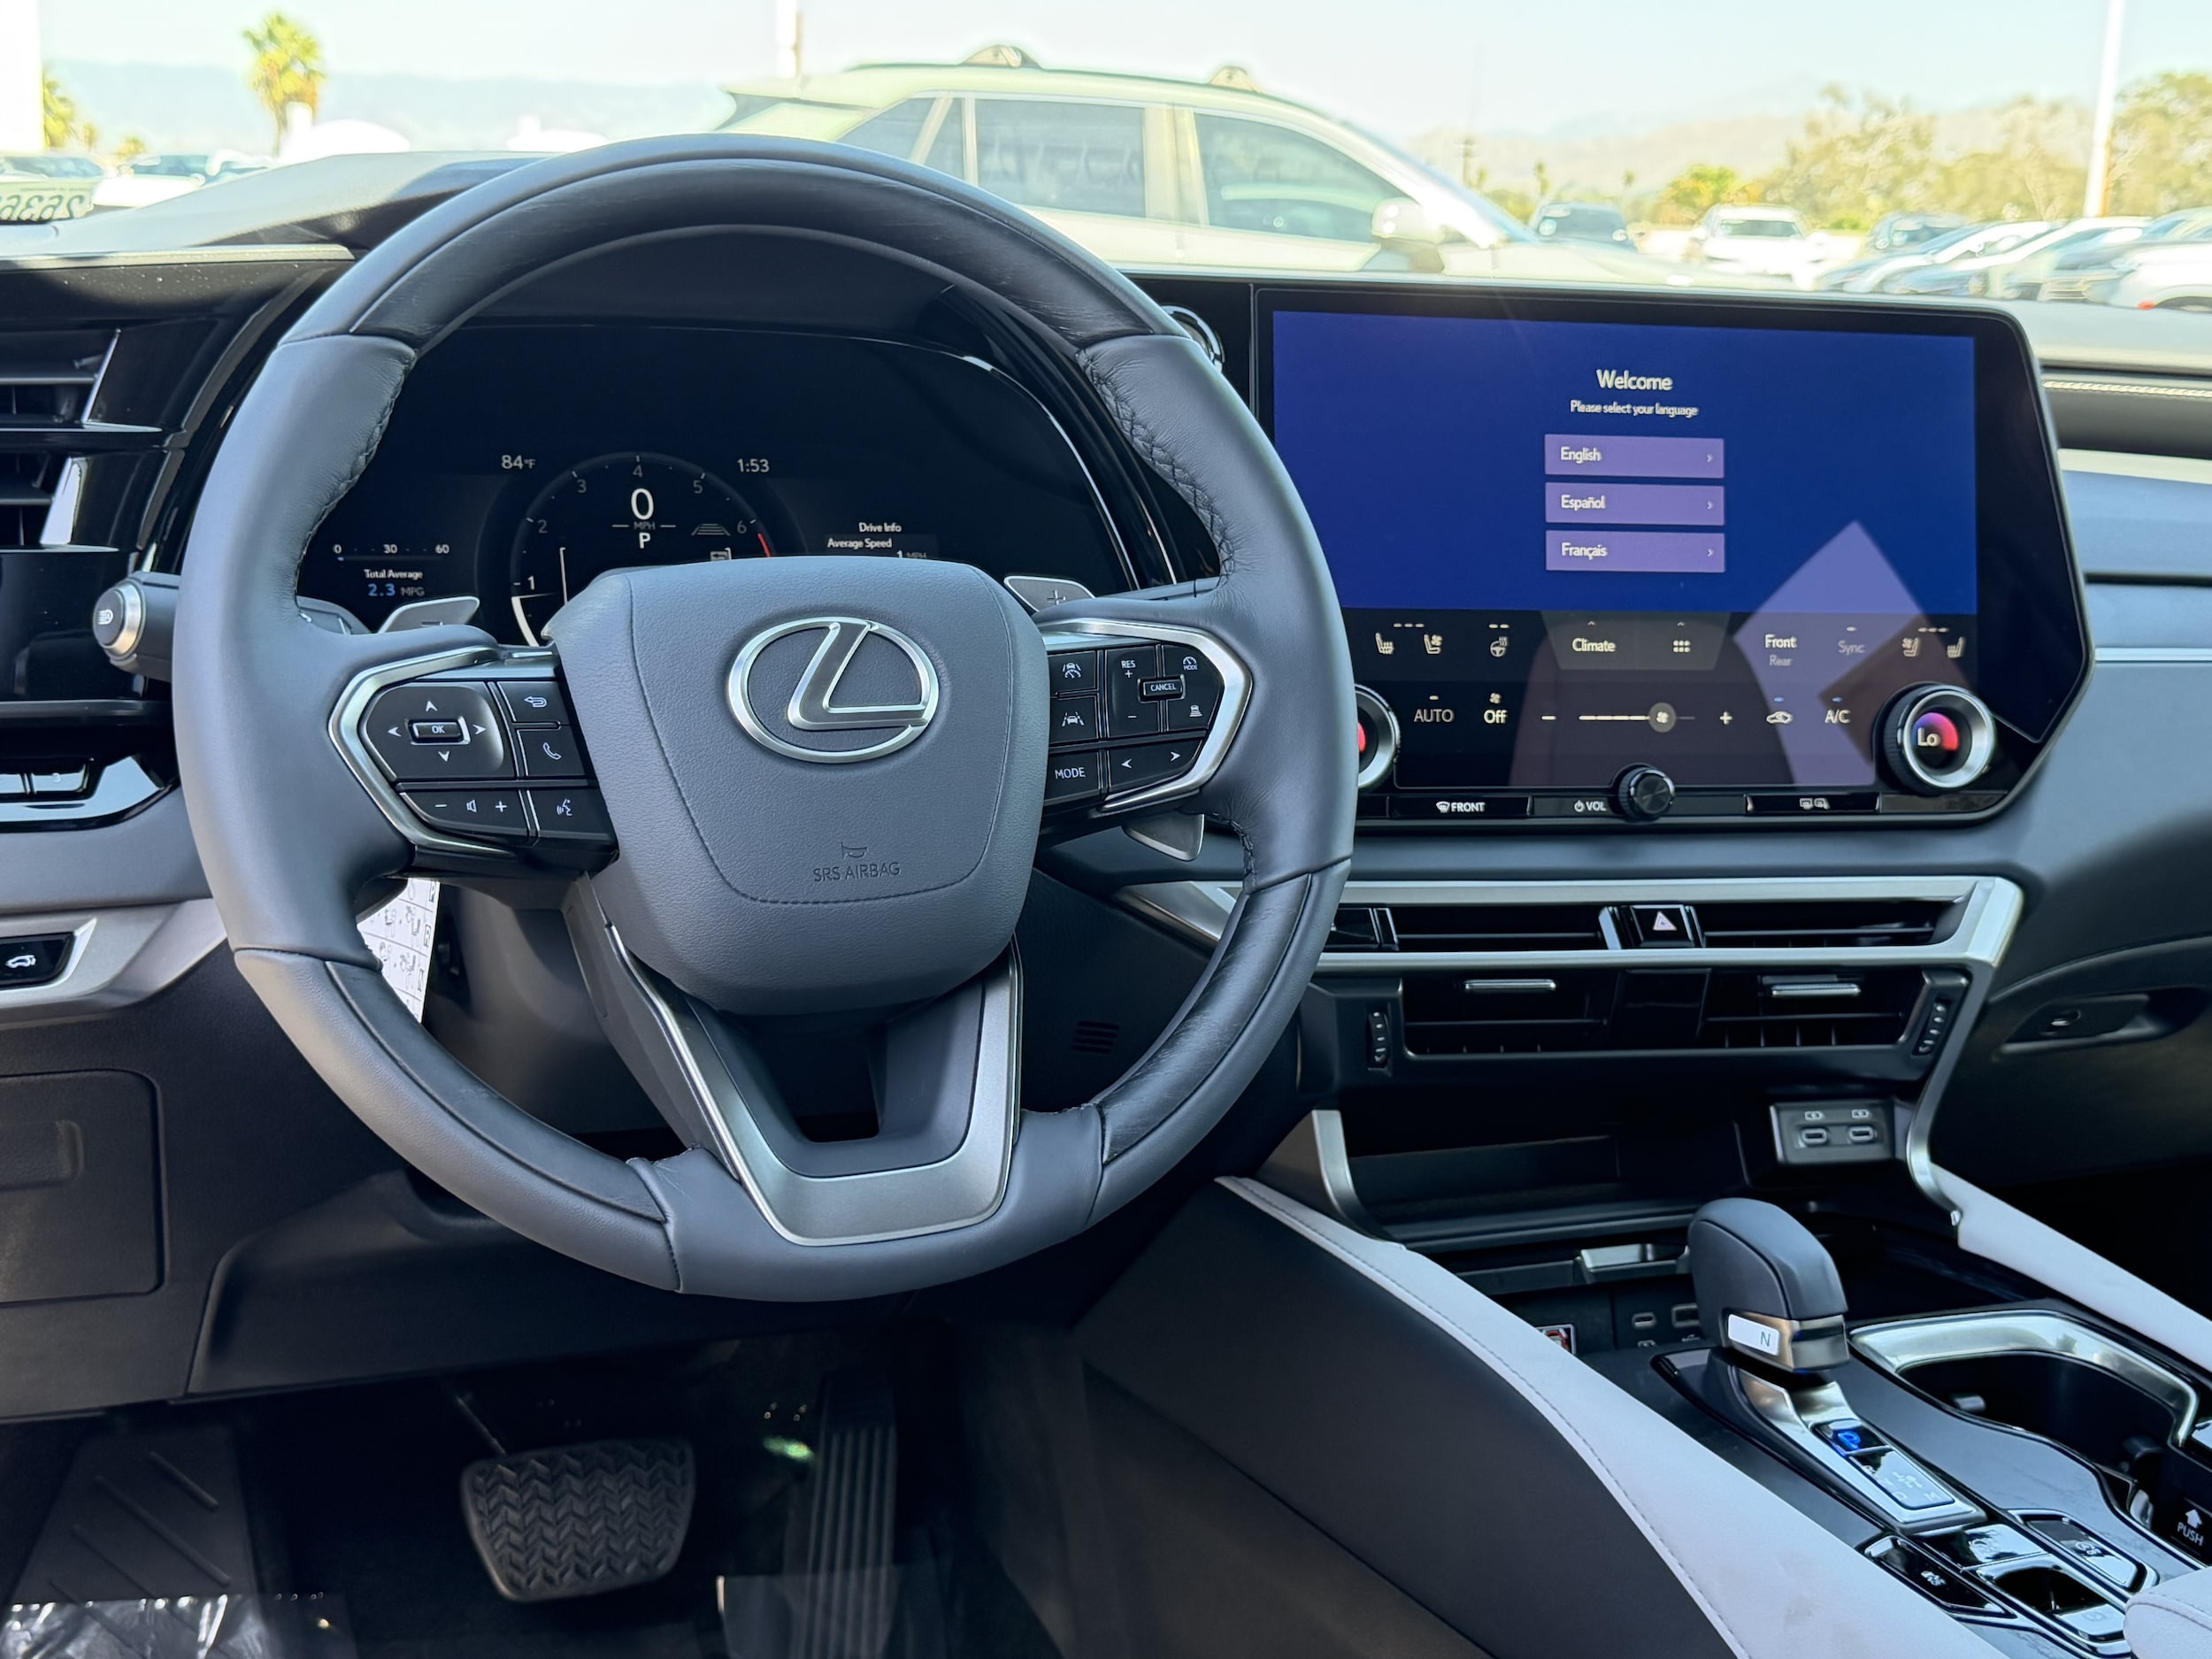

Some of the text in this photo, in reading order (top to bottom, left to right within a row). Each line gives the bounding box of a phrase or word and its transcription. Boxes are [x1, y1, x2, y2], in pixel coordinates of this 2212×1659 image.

[1595, 369, 1673, 390] Welcome
[1570, 400, 1699, 418] Please select your language
[1560, 446, 1602, 464] English
[632, 465, 643, 478] 4
[737, 458, 770, 473] 1:53
[577, 479, 587, 493] 3
[693, 480, 703, 494] 5
[631, 488, 654, 520] 0
[1561, 495, 1606, 511] Español
[537, 519, 548, 534] 2
[634, 520, 656, 530] MPH
[736, 520, 748, 534] 6
[858, 522, 902, 533] Drive Info
[639, 533, 651, 549] P
[826, 538, 892, 550] Average Speed
[333, 544, 449, 554] 0 30 60
[1561, 541, 1608, 559] Français
[364, 569, 424, 580] Total Average
[527, 576, 535, 590] 1
[367, 584, 425, 597] 2.3 MPG
[1571, 637, 1617, 653] Climate
[1764, 634, 1797, 649] Front
[1838, 640, 1865, 656] Sync
[1121, 660, 1136, 669] RES
[1769, 655, 1793, 666] Rear
[1150, 683, 1177, 692] CANCEL
[1414, 709, 1454, 723] AUTO
[1483, 709, 1508, 724] Off
[1824, 709, 1850, 724] A/C
[432, 724, 446, 734] OK
[1917, 727, 1940, 747] Lo
[1055, 767, 1086, 780] MODE
[1451, 802, 1486, 812] FRONT
[1586, 801, 1607, 811] VOL
[813, 861, 901, 882] SRS AIRBAG
[2177, 1522, 2205, 1547] PUSH
